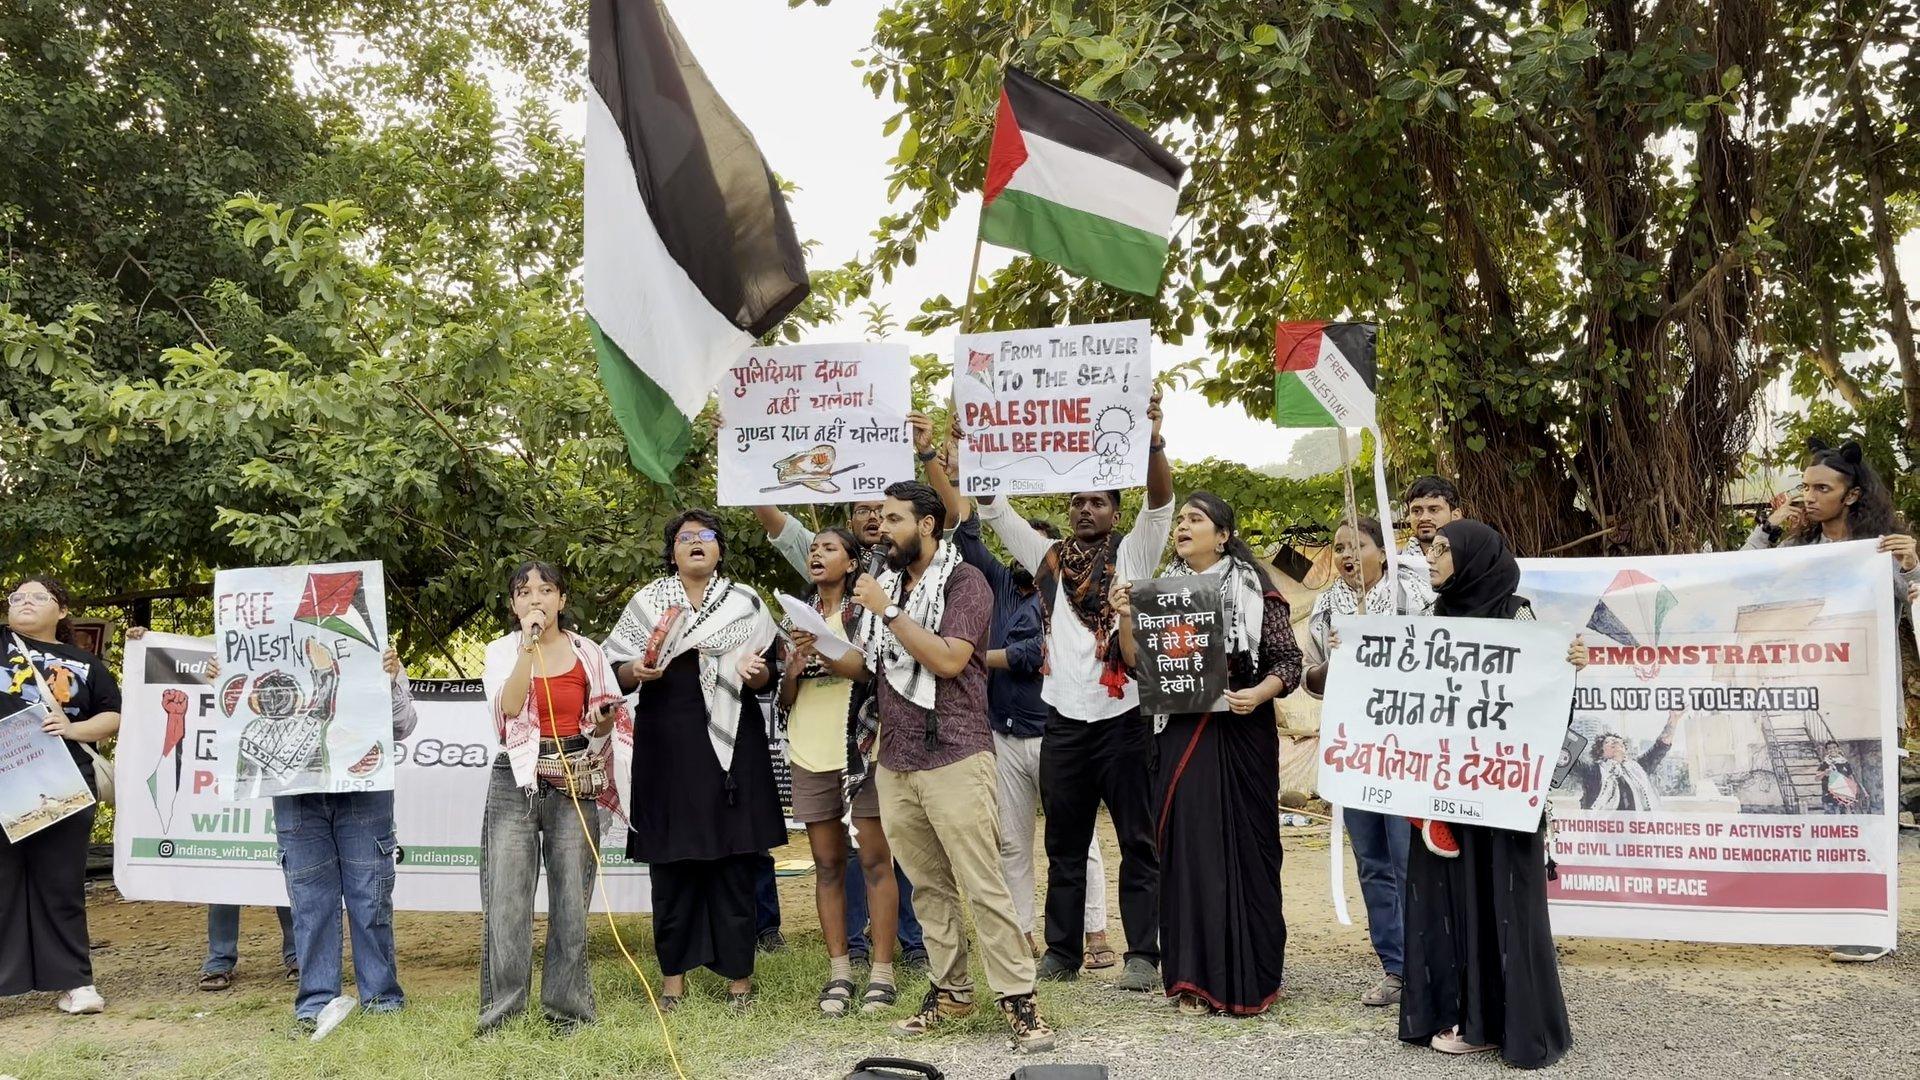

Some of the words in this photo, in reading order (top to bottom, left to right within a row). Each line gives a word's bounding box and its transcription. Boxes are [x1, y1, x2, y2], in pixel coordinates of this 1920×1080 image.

[999, 341, 1042, 362] FROM
[1048, 338, 1077, 358] THE
[1082, 335, 1138, 356] RIVER
[814, 360, 862, 383] दमन
[1325, 353, 1349, 382] FREE
[999, 369, 1024, 393] TO
[1032, 368, 1068, 389] THE
[767, 388, 801, 415] नहीं
[1306, 370, 1349, 420] PALESTINE
[965, 397, 1091, 427] PALESTINE
[735, 424, 776, 453] गुण्डा
[781, 425, 811, 442] राज
[814, 417, 846, 444] नहीं
[967, 432, 1009, 453] WILL
[1012, 431, 1037, 453] BE
[852, 477, 886, 491] IPSP
[967, 476, 1000, 492] IPSP
[1157, 593, 1178, 607] दम
[1180, 588, 1192, 607] है
[218, 592, 275, 629] FREE
[1138, 613, 1181, 630] कितना
[1184, 611, 1216, 626] दमन
[225, 623, 350, 671] PALESTINE
[1147, 633, 1159, 651] में
[1162, 631, 1181, 650] तेरे
[1184, 631, 1209, 648] देख
[1356, 635, 1396, 667] दम
[1398, 624, 1420, 672] है
[1424, 628, 1521, 675] कितना
[1156, 654, 1189, 673] लिया
[1192, 652, 1203, 672] है
[1587, 642, 1850, 666] EMONSTRATION
[175, 659, 208, 674] Indi
[440, 681, 483, 693] Pales
[1366, 688, 1425, 726] दमन
[1430, 677, 1462, 727] में
[1467, 679, 1513, 731] तेरे
[1574, 688, 1607, 711] ILL
[1611, 688, 1651, 711] NOT
[1656, 687, 1685, 711] BE
[1689, 687, 1819, 711] TOLERATED!
[413, 739, 489, 767] Sea
[1324, 723, 1375, 774] देख
[1377, 733, 1433, 782] लिया
[1433, 738, 1450, 791] है
[335, 780, 375, 791] IPSP
[1362, 786, 1393, 804] IPSP
[1433, 799, 1456, 814] BDS
[1460, 803, 1481, 818] India
[192, 808, 251, 834] will
[1552, 819, 1624, 834] UTHORISED
[1629, 821, 1701, 836] SEARCHES
[1705, 823, 1724, 836] OF
[1811, 825, 1859, 838] HOMES
[175, 843, 278, 859] indians_with_pale
[1556, 842, 1573, 855] ON
[1577, 843, 1611, 856] CIVIL
[1616, 844, 1683, 859] LIBERTIES
[1688, 847, 1717, 860] AND
[1723, 848, 1812, 862] DEMOCRATIC
[1817, 849, 1871, 862] RIGHTS.
[1561, 874, 1620, 892] MUMBAI
[1624, 876, 1653, 894] FOR
[1657, 878, 1708, 896] PEACE
